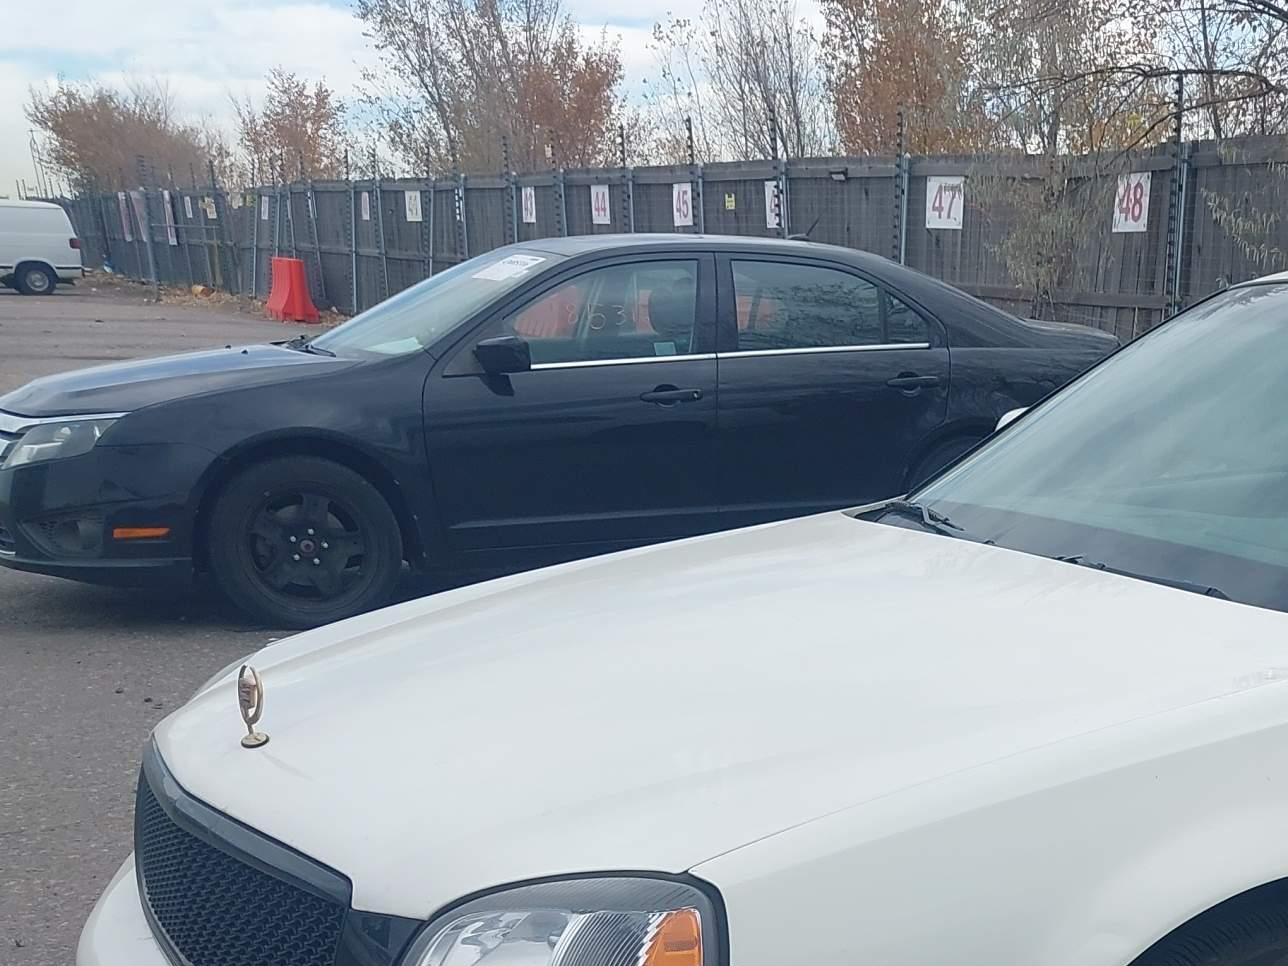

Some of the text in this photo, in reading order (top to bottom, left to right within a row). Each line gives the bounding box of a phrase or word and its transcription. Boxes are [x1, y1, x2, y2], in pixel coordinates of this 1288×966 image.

[593, 191, 607, 217] 44
[675, 189, 689, 219] 45
[931, 183, 962, 220] 47
[1119, 182, 1144, 223] 48
